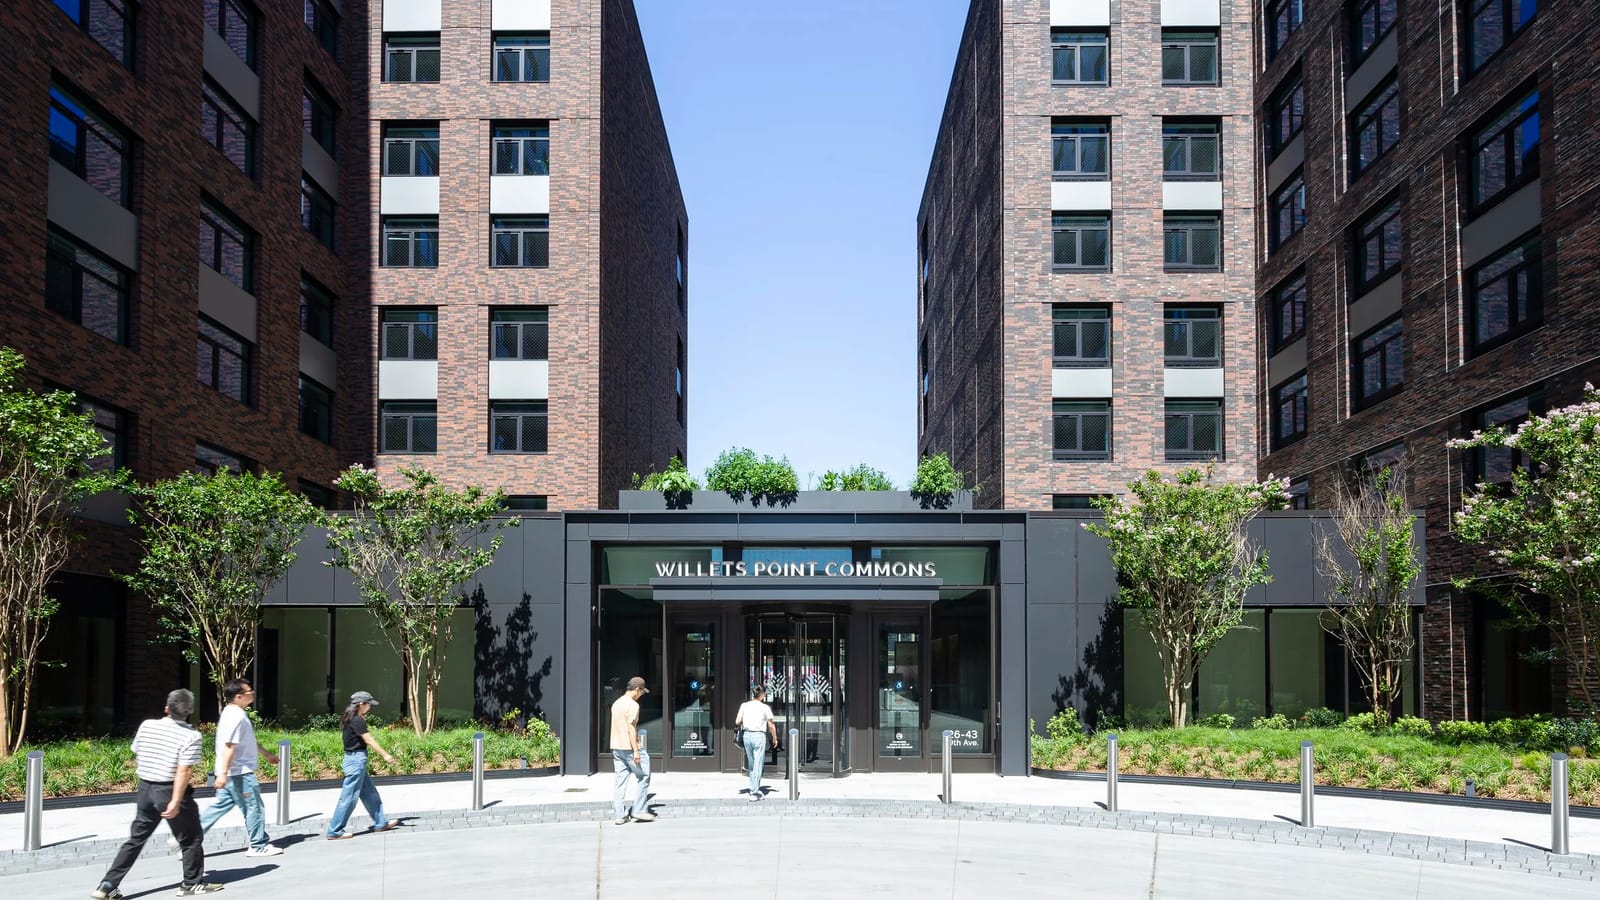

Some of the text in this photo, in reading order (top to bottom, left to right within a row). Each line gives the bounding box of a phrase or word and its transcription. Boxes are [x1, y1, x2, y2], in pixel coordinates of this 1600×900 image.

[656, 560, 936, 576] WILLETS POINT COMMONS
